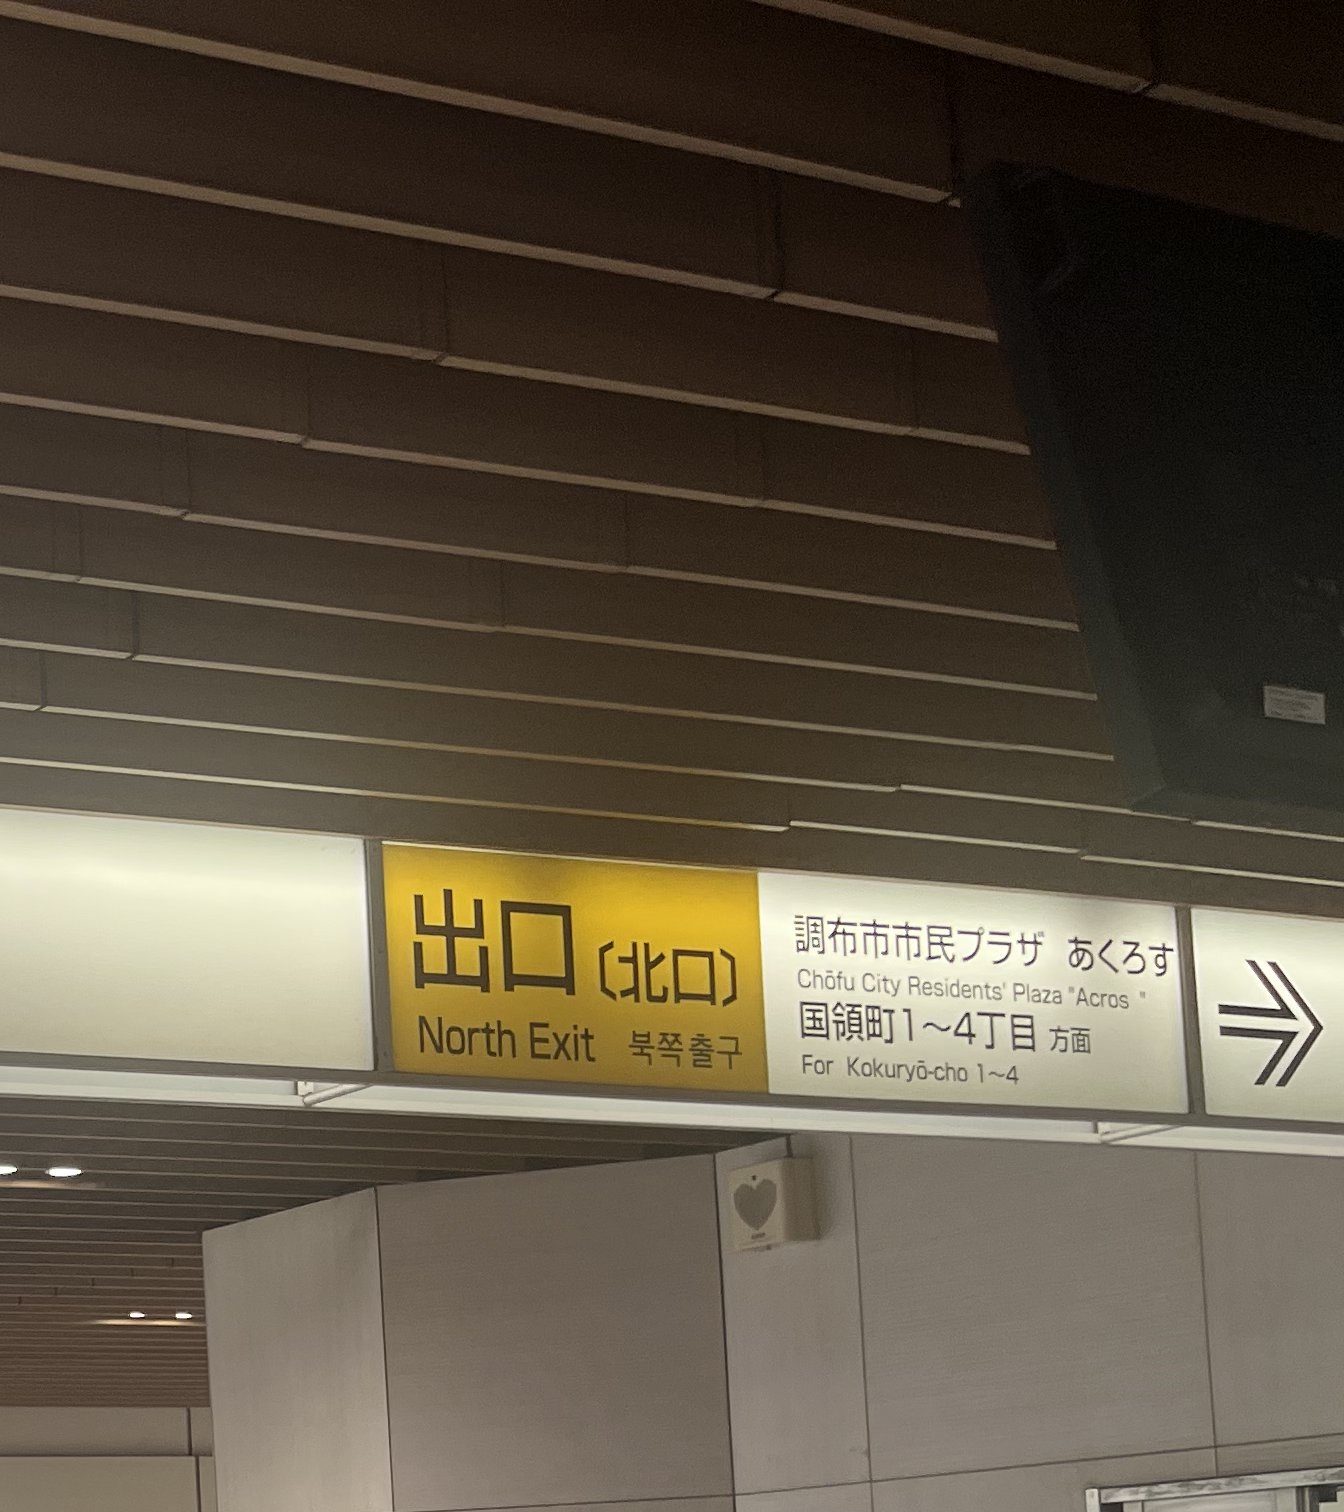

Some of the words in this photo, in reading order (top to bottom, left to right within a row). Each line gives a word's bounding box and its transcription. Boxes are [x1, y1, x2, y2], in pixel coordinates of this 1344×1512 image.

[413, 888, 576, 995] 出口
[794, 915, 1045, 966] 調布市市民プラザ
[1068, 936, 1174, 977] あくろす
[862, 973, 901, 998] City
[1013, 982, 1063, 1005] Plaza
[418, 1015, 517, 1058] North
[529, 1022, 596, 1062] Exit
[1049, 1025, 1091, 1054] 方面
[802, 1054, 833, 1075] For
